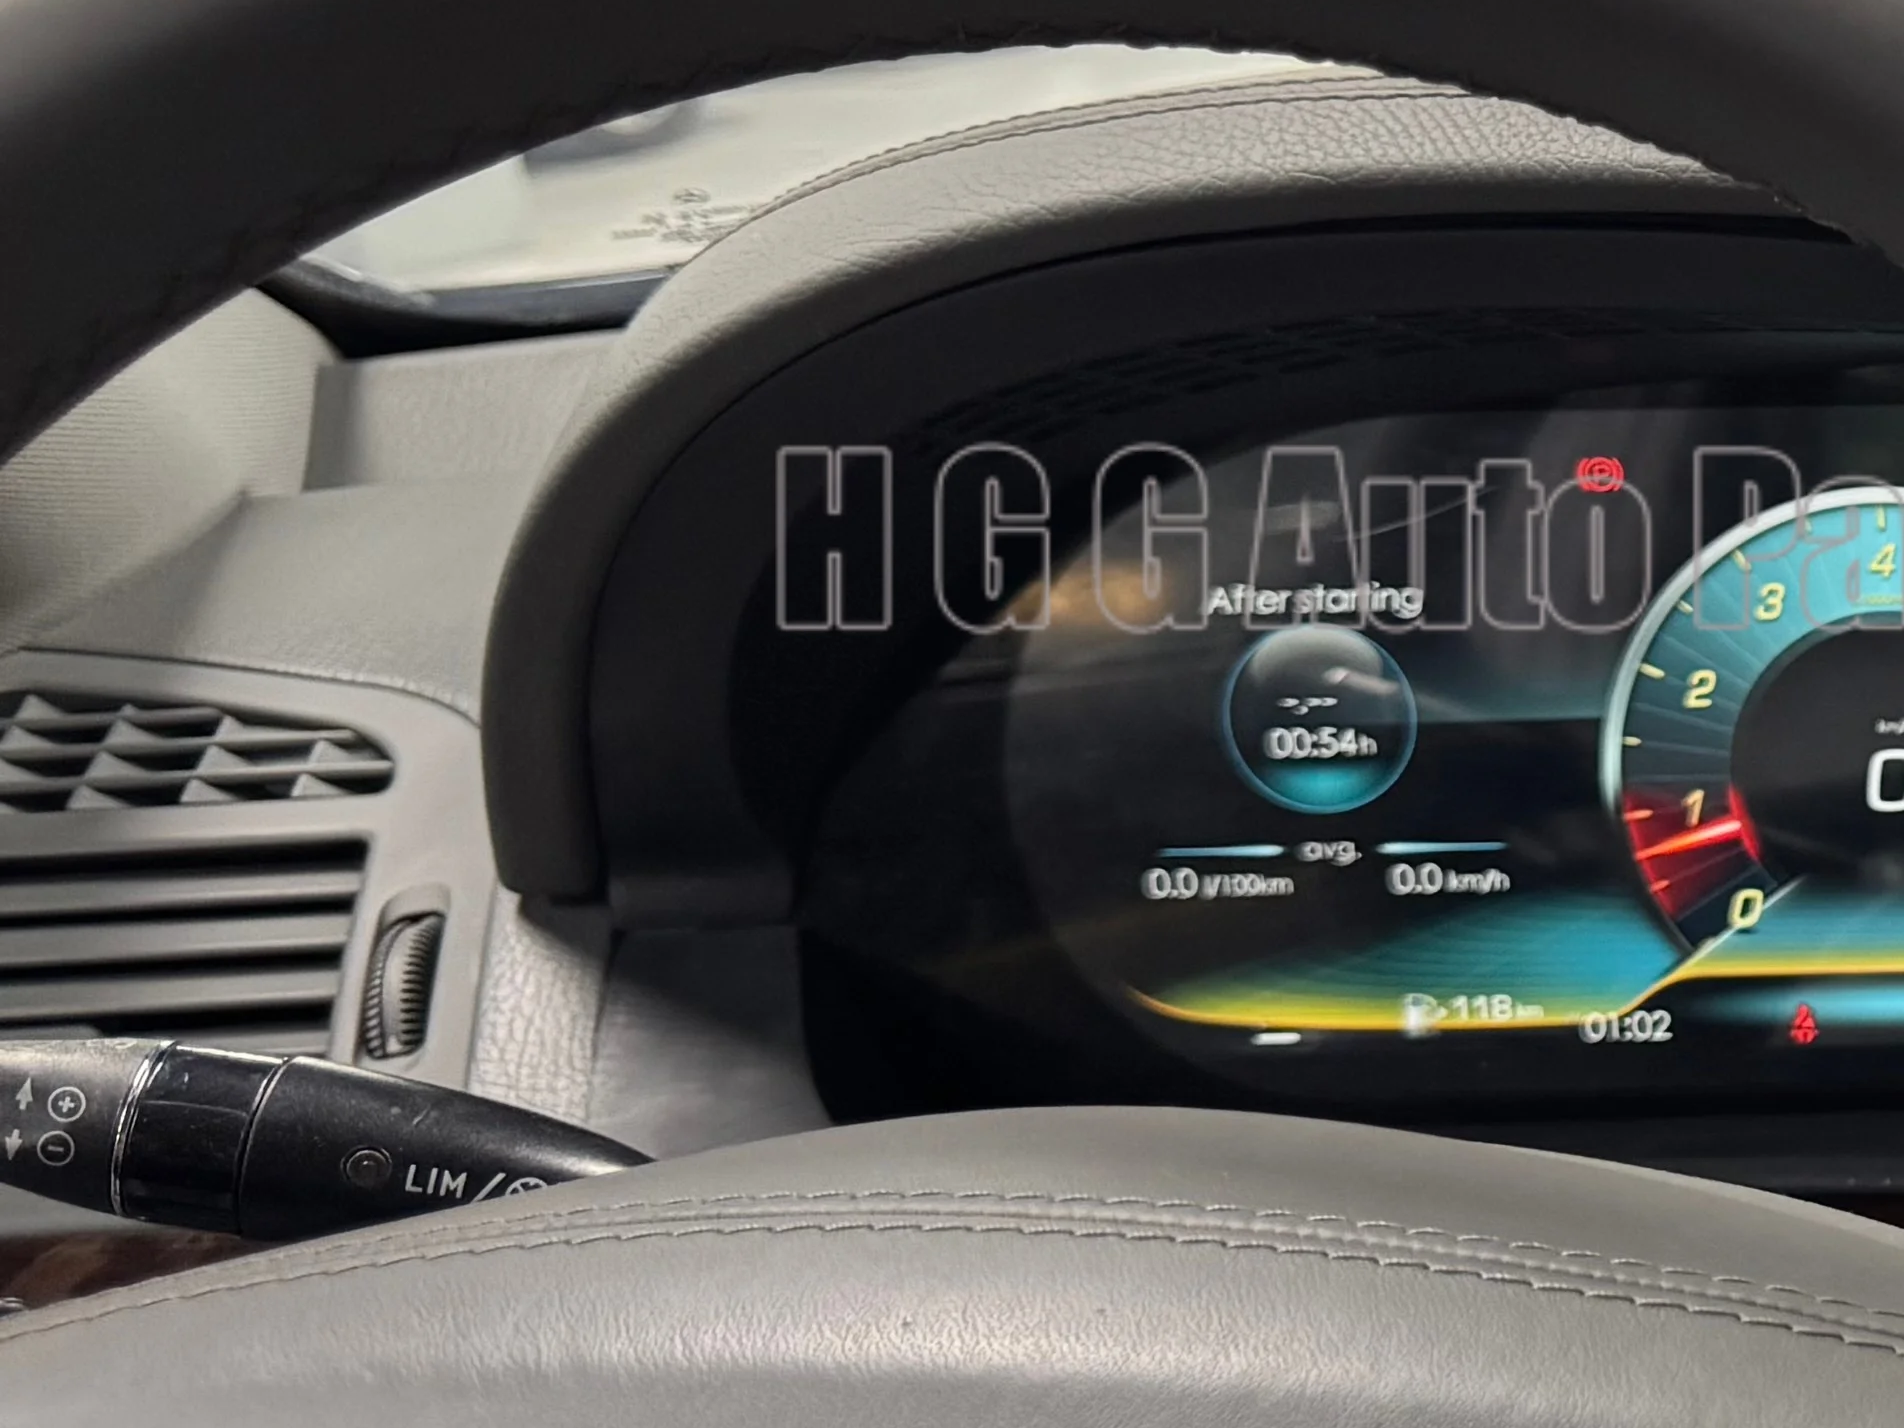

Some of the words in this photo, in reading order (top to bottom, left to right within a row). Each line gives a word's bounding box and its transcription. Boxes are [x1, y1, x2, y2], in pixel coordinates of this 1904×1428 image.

[1868, 543, 1898, 579] 4
[1206, 581, 1292, 615] After
[1293, 581, 1425, 620] starting
[1753, 582, 1786, 621] 3
[1682, 669, 1717, 709] 2
[1682, 789, 1705, 826] 1
[1295, 840, 1363, 867] avg.
[1141, 866, 1199, 900] 0.0
[1384, 861, 1443, 896] 0.0
[1728, 887, 1765, 929] 0
[1450, 993, 1513, 1021] 118
[1577, 1009, 1674, 1044] 01:02
[404, 1162, 468, 1200] LIM
